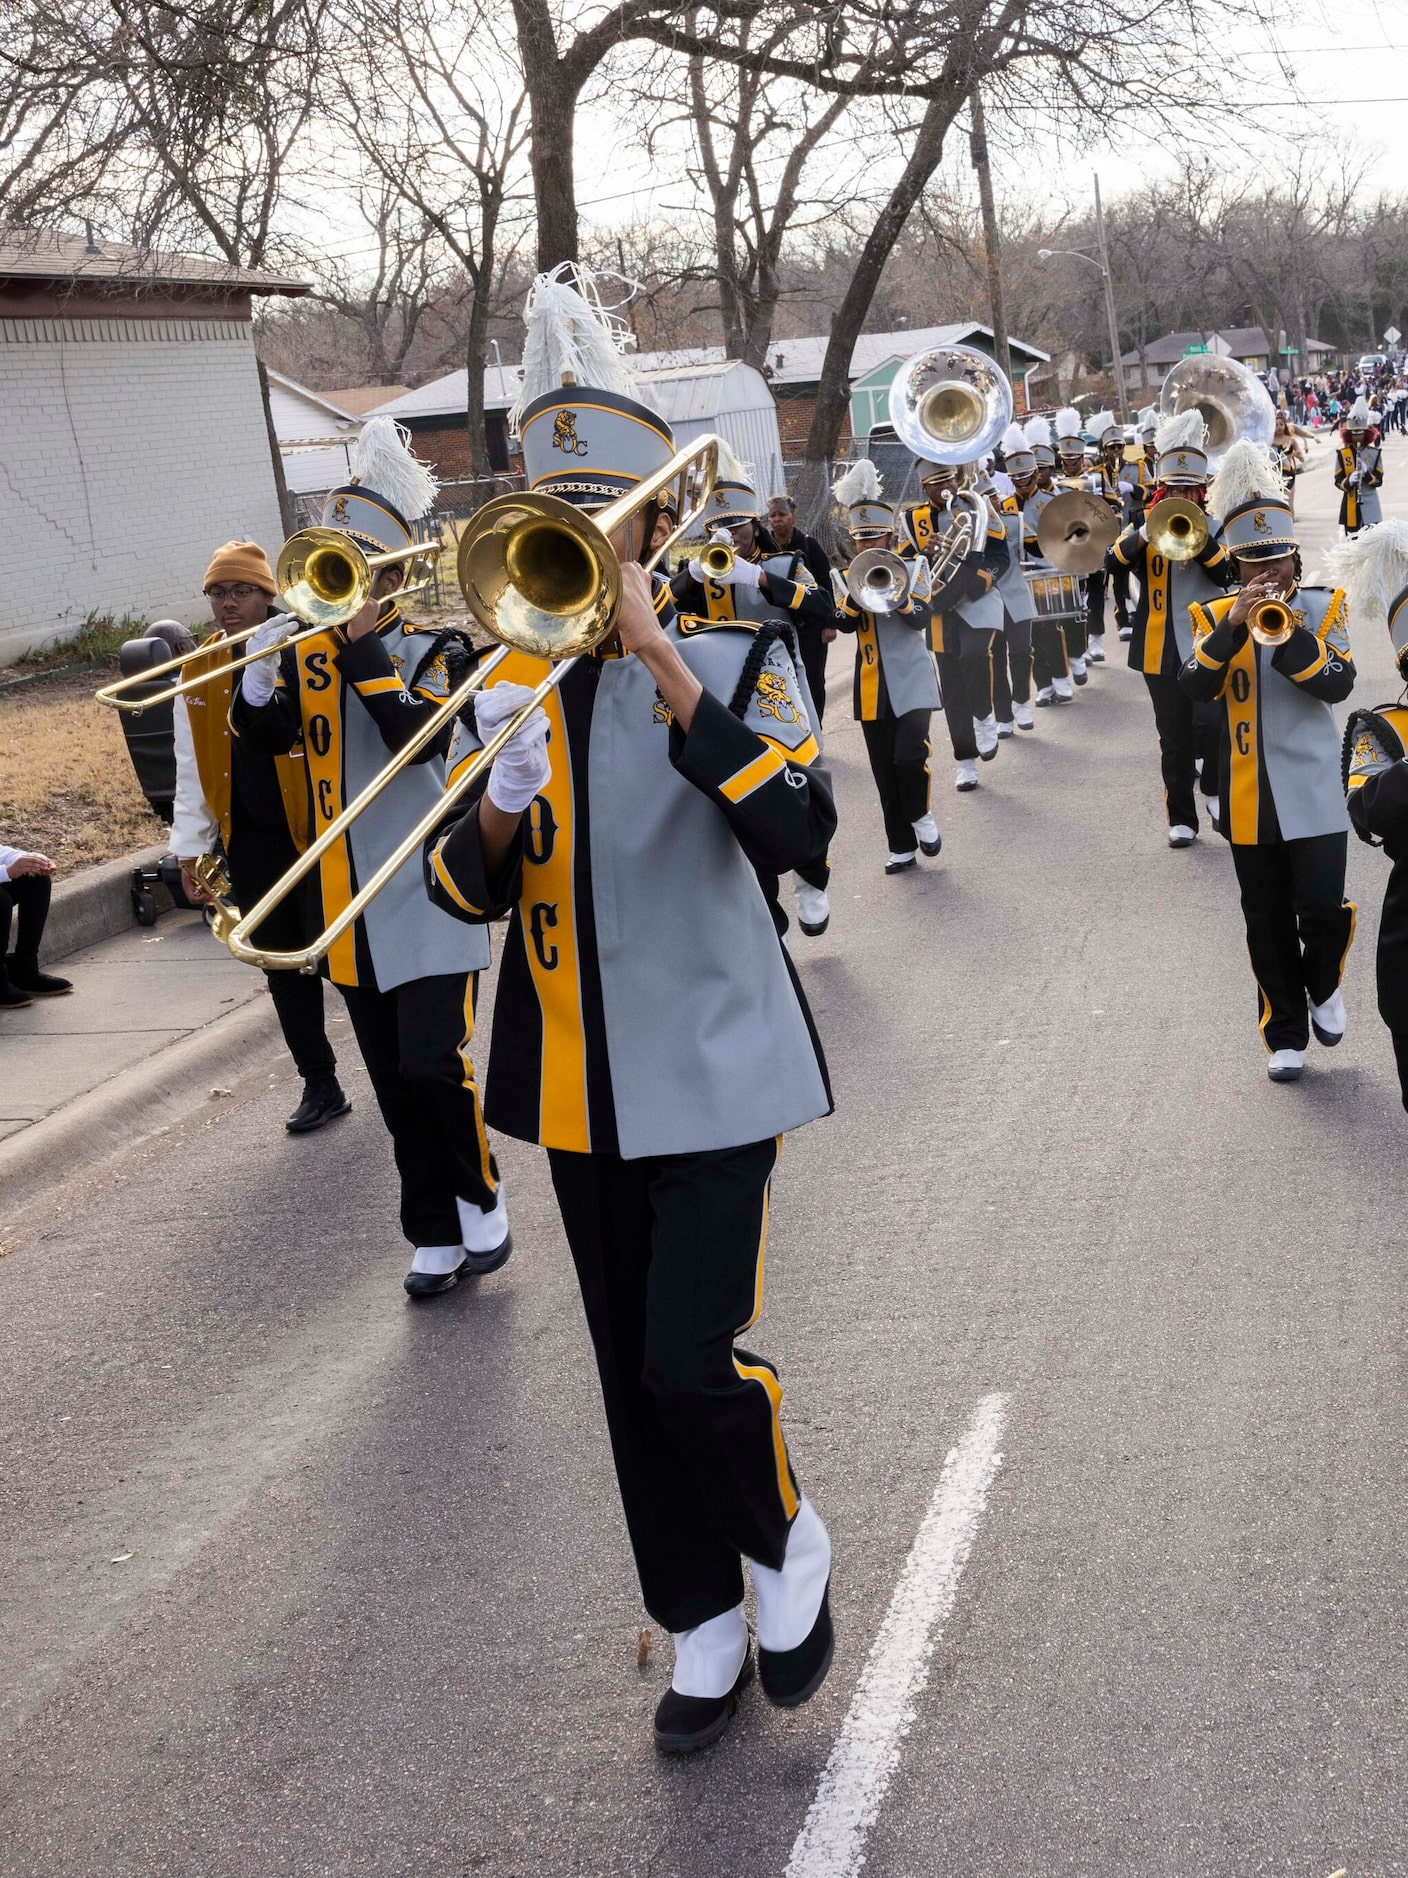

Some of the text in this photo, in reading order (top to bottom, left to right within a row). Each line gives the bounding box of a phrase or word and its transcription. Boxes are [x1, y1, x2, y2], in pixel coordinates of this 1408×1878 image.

[553, 431, 588, 457] SOC
[1152, 554, 1164, 611] OC
[304, 652, 335, 822] SOC
[757, 697, 809, 734] SOC
[1231, 668, 1251, 756] OC
